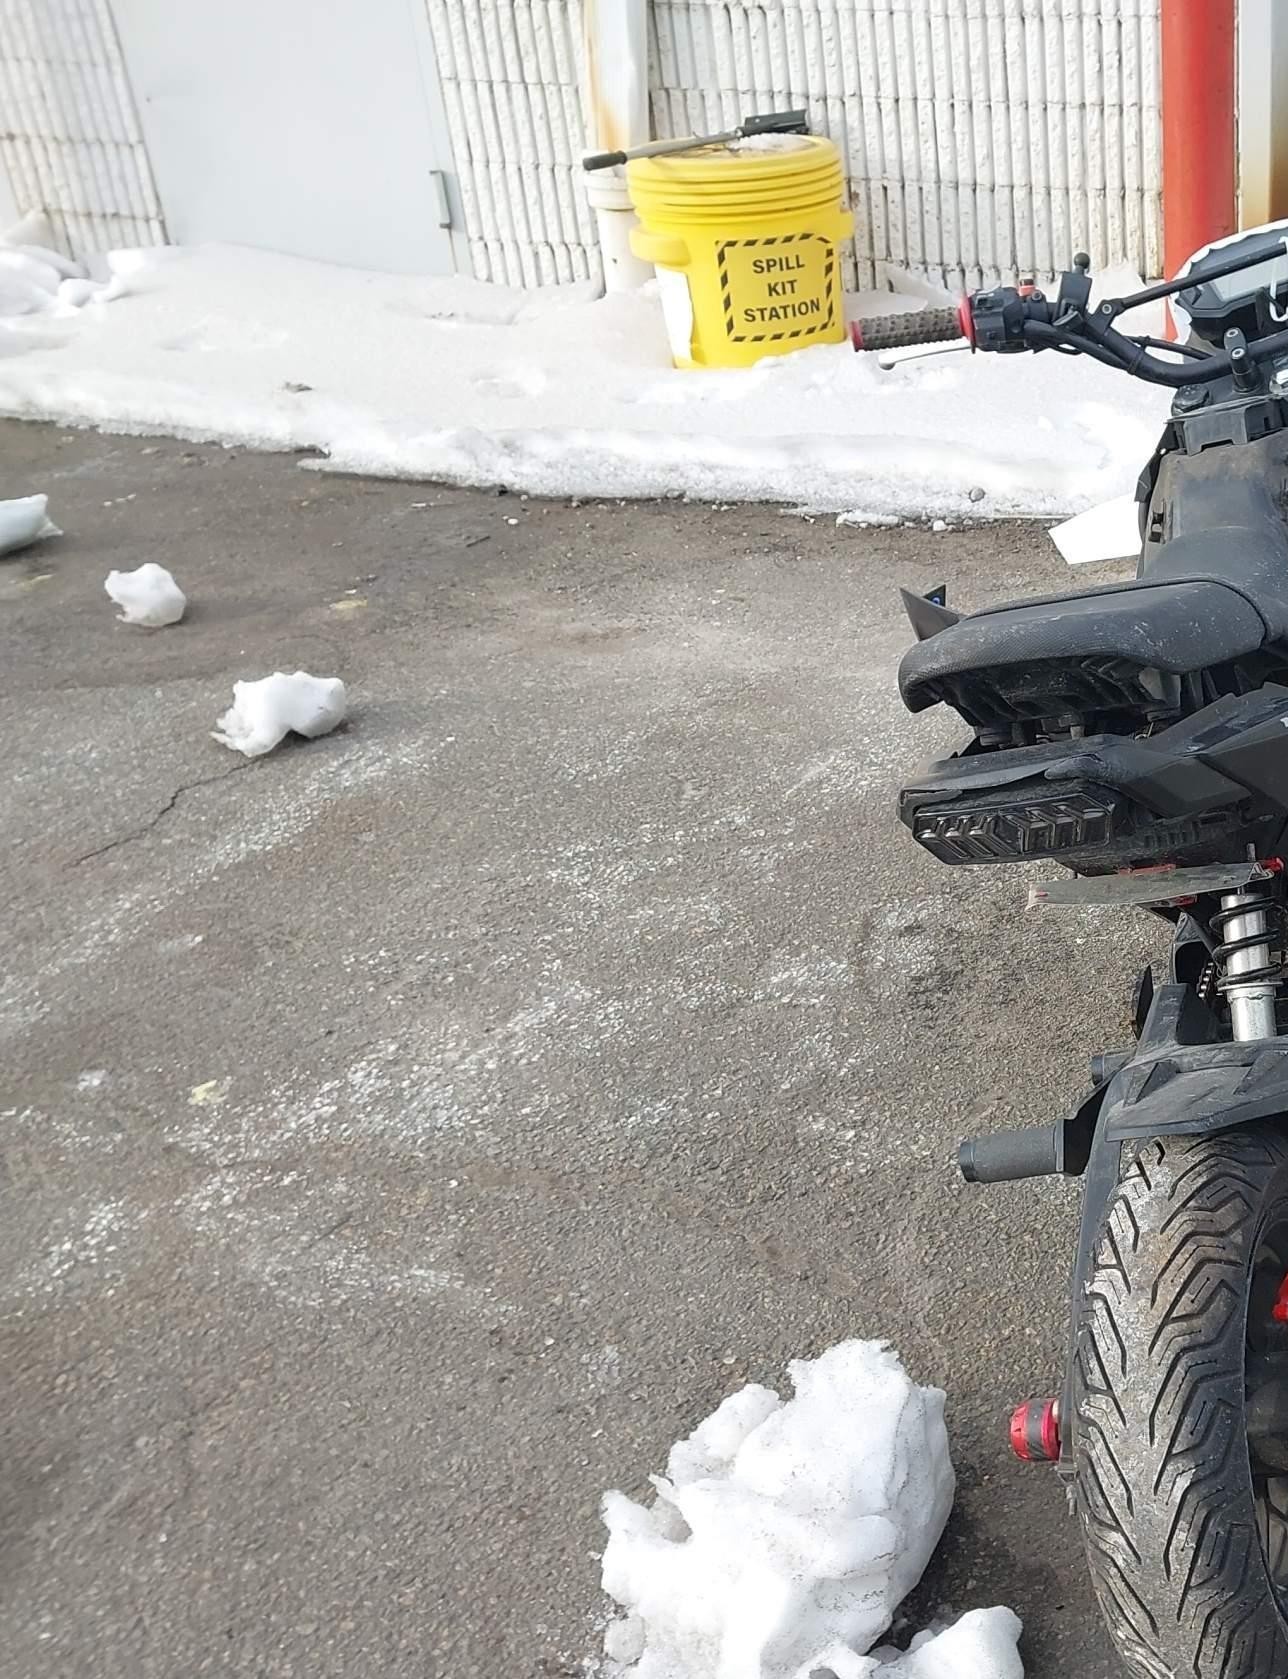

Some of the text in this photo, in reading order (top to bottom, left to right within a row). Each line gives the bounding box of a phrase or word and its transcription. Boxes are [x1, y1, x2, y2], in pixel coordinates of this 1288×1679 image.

[752, 254, 806, 274] SPILL
[767, 279, 798, 297] KIT
[743, 297, 820, 323] STATION
